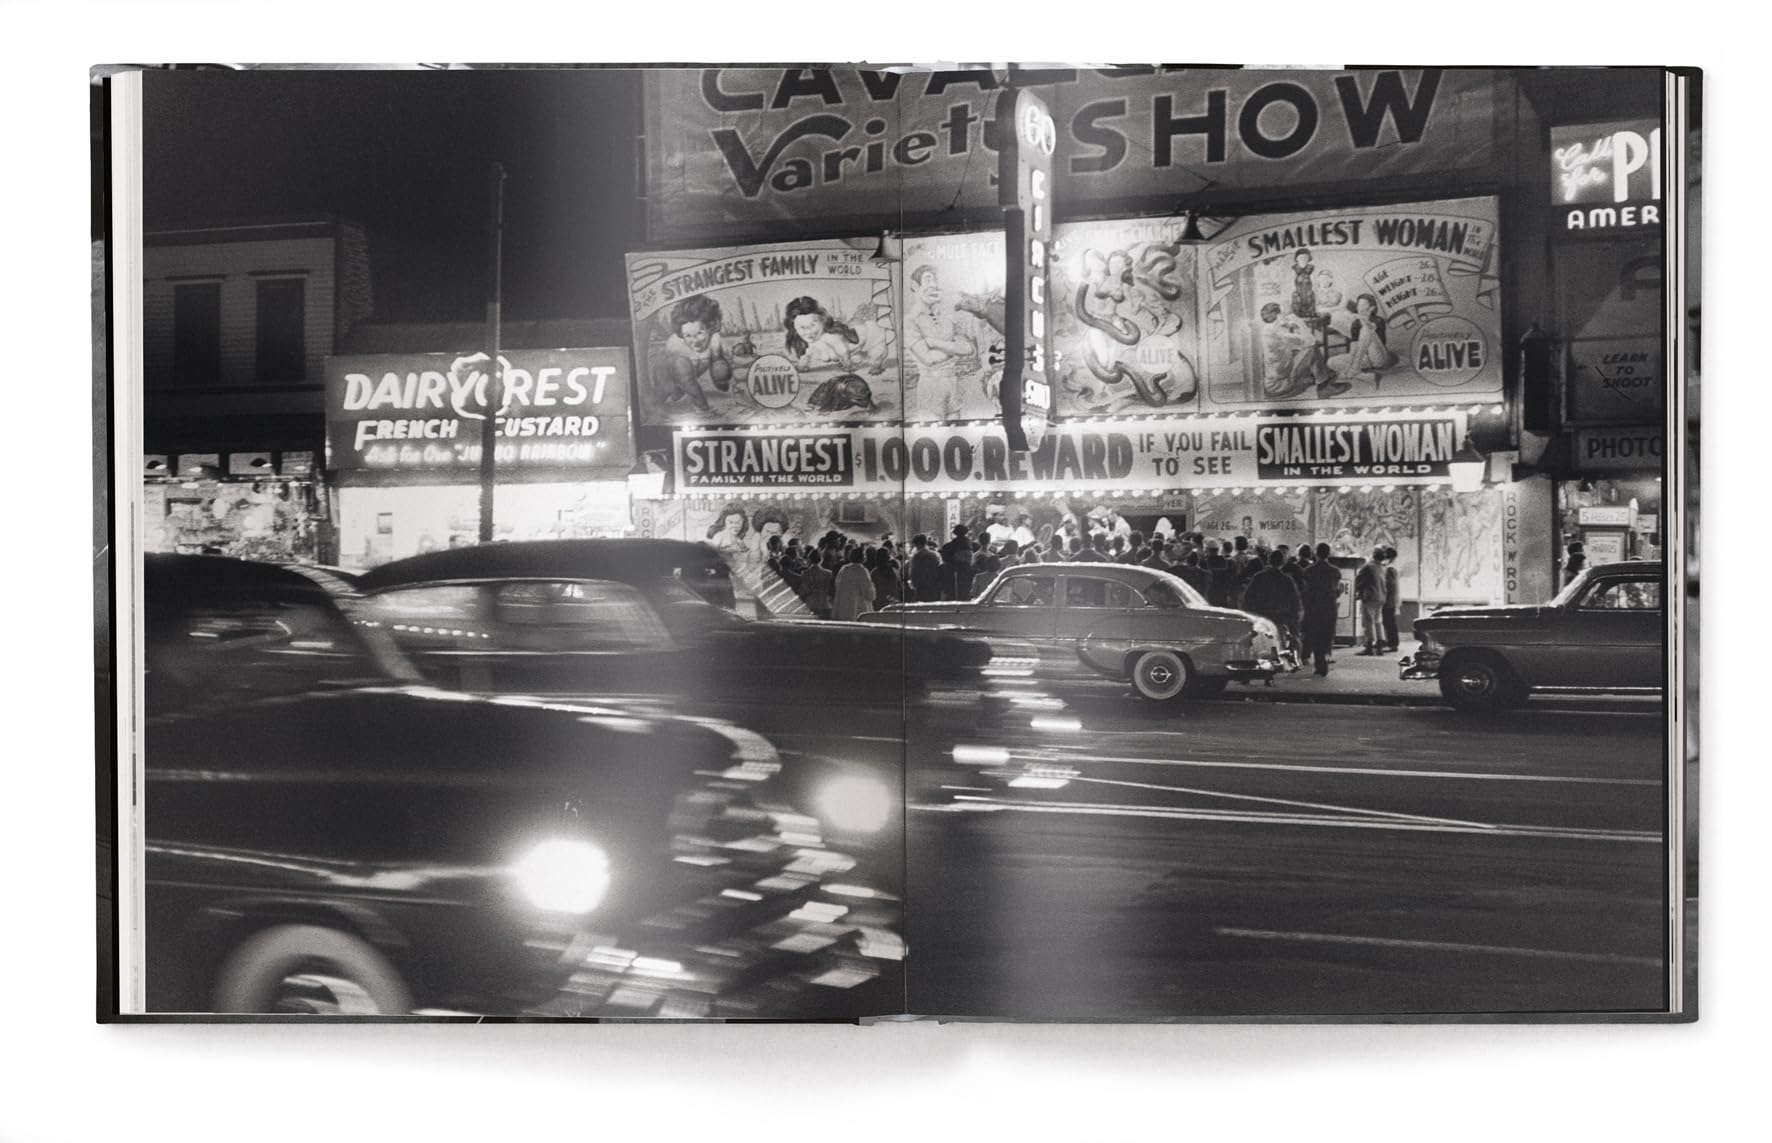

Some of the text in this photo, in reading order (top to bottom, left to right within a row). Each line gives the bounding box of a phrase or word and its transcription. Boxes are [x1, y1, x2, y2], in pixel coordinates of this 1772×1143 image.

[1070, 69, 1442, 173] SHOW
[1248, 218, 1364, 258] SMALLEST
[1375, 218, 1468, 255] WOMAN
[662, 258, 754, 300] STRANGEST
[759, 254, 819, 277] FAMILY
[827, 254, 838, 262] IN
[843, 254, 864, 262] THE
[827, 264, 862, 275] WORLD
[1419, 341, 1481, 370] ALIVE
[1602, 376, 1653, 388] SHOOT
[1616, 365, 1634, 375] TO
[344, 370, 480, 411] DAIRY
[754, 374, 796, 396] ALIVE
[354, 418, 458, 451] FRENCH
[686, 438, 848, 473] STRANGEST
[1139, 432, 1155, 453] IF
[1164, 431, 1204, 451] YOU
[1210, 430, 1252, 452] FAIL
[1258, 425, 1364, 464] SMALLEST
[1367, 422, 1453, 463] WOMAN
[690, 474, 842, 484] FAMILY IN THE WORLD
[1151, 456, 1233, 477] TO SEE
[1284, 464, 1432, 476] IN THE WORLD
